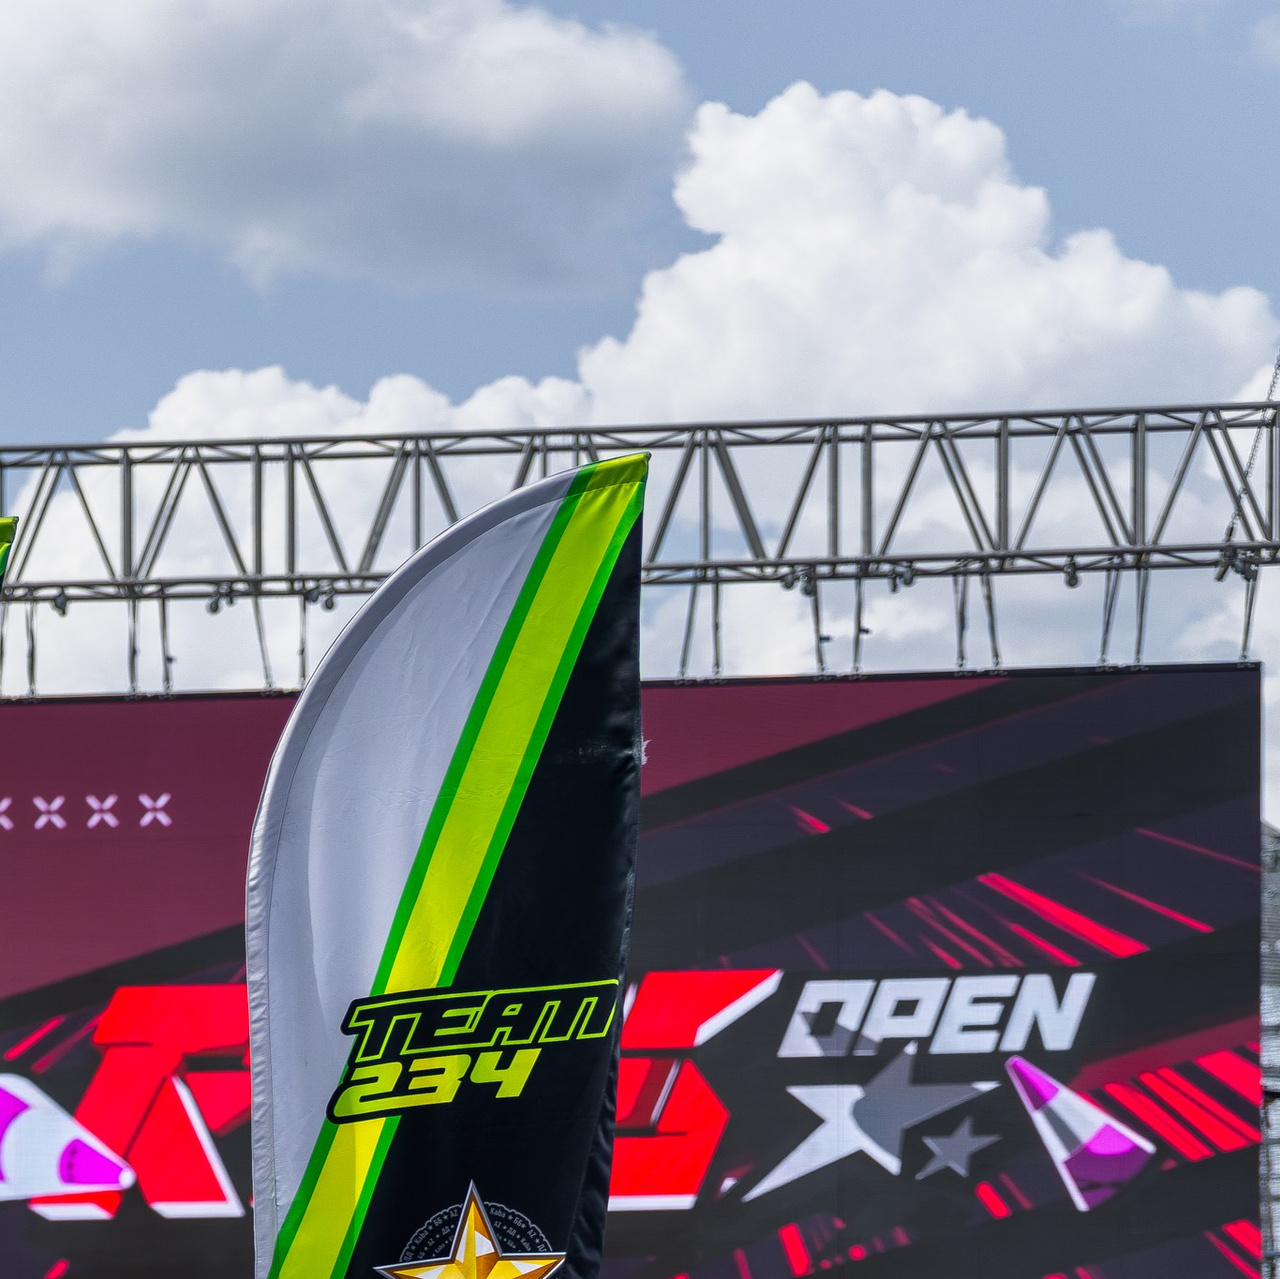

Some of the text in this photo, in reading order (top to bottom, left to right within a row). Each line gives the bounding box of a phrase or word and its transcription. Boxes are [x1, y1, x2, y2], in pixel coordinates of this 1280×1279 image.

[349, 979, 619, 1063] TEAM
[778, 973, 1096, 1057] OPEN
[333, 1048, 542, 1117] 234
